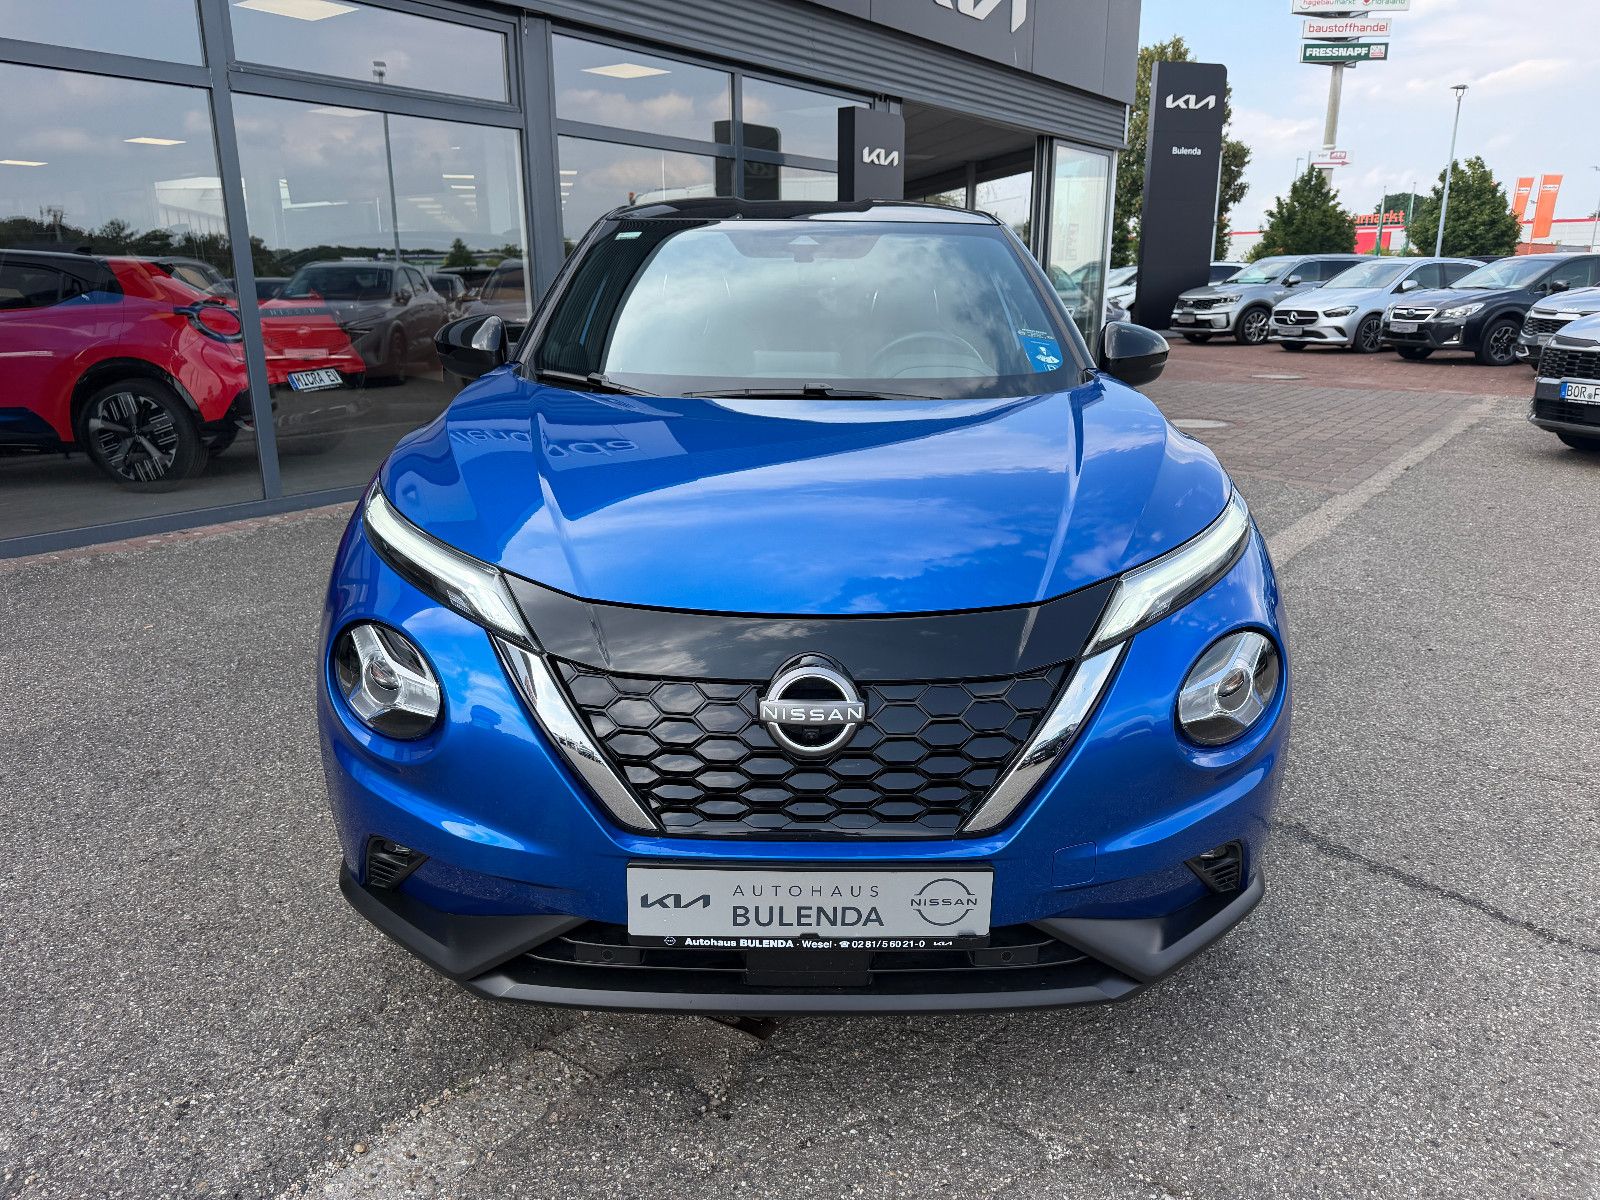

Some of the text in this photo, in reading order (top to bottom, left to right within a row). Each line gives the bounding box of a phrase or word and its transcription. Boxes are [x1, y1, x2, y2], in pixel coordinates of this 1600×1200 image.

[1308, 22, 1388, 33] baustoffhandel
[1305, 47, 1369, 57] FRESSNAPF
[1165, 93, 1216, 110] KIA
[862, 146, 899, 167] KIA
[1172, 146, 1202, 156] Bulenda
[294, 372, 325, 389] MICRA
[1566, 384, 1587, 399] BOR
[762, 705, 863, 721] NISSAN
[733, 885, 879, 897] AUTOHAUS
[640, 893, 711, 908] KIA
[910, 898, 978, 906] NISSAN
[732, 906, 885, 926] BULENDA
[685, 937, 737, 947] Autohaus
[739, 939, 794, 948] BULENDA
[801, 940, 833, 949] Wesel
